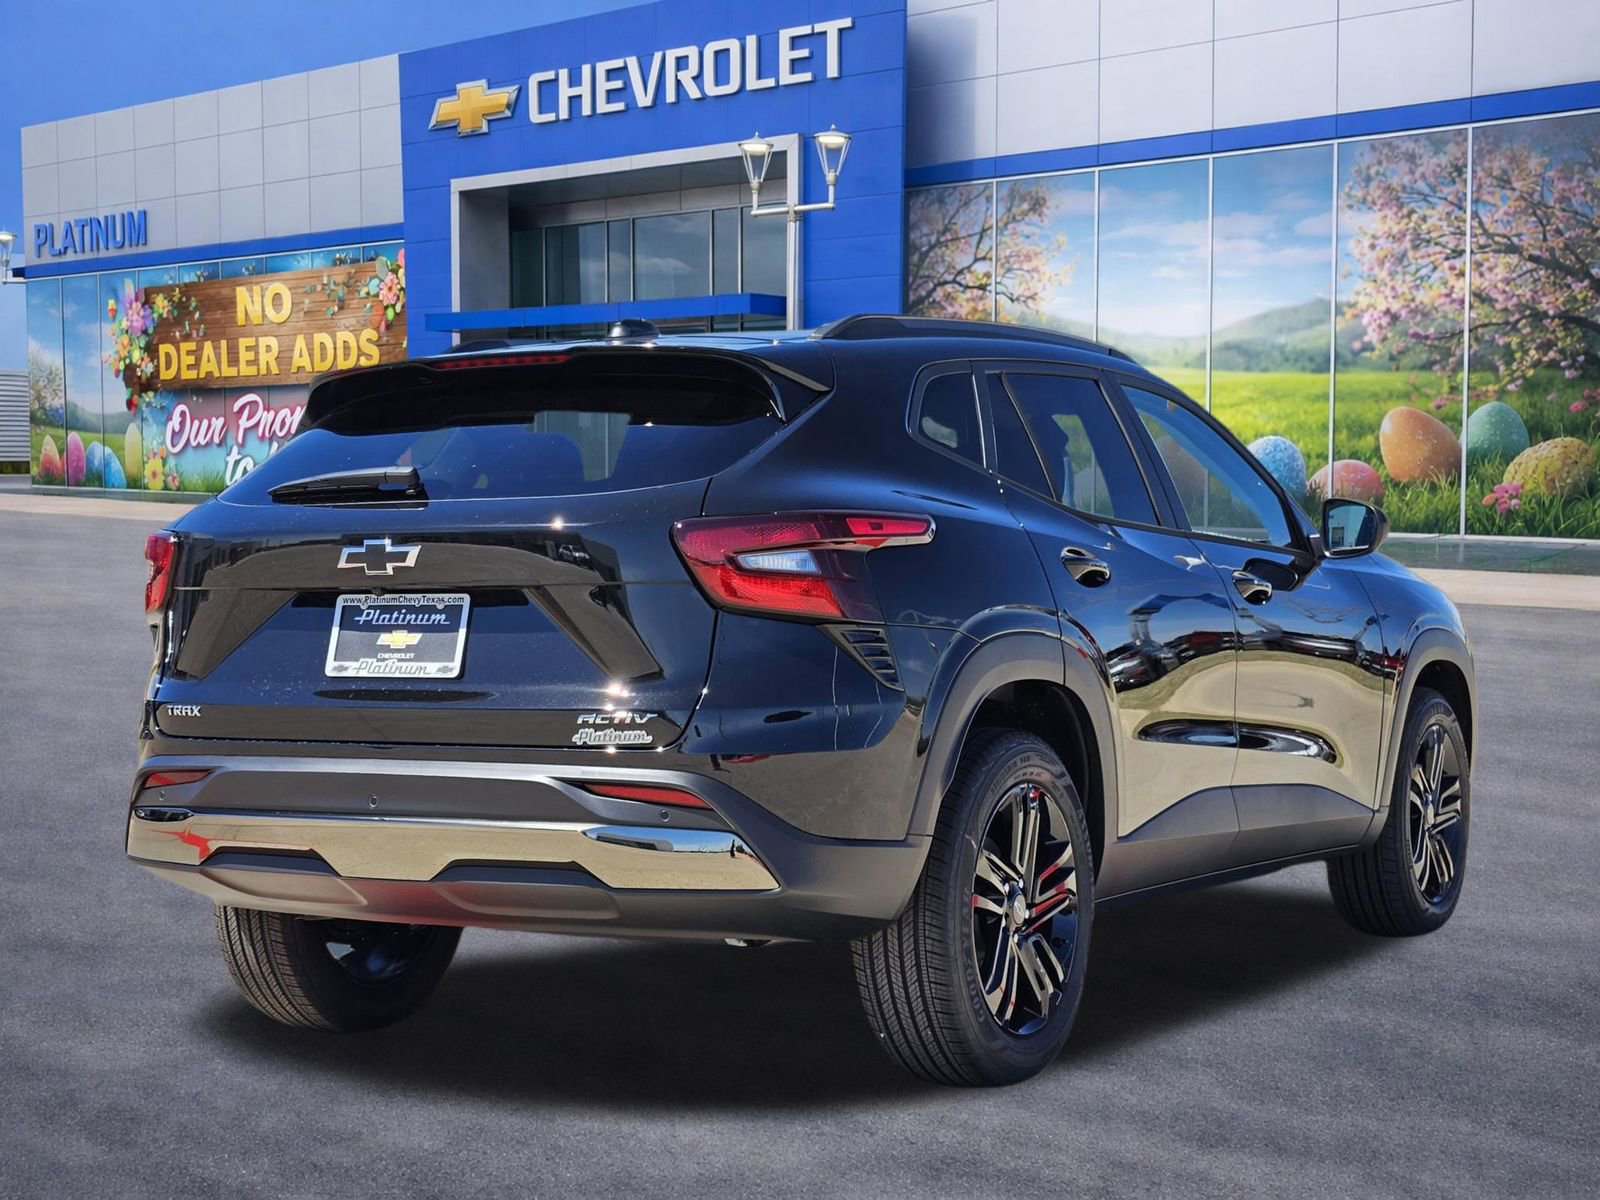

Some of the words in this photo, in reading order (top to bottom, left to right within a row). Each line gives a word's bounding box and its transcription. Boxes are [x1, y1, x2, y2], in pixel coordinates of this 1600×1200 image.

[528, 16, 854, 125] CHEVROLET
[34, 209, 147, 259] PLATINUM
[235, 282, 292, 326] NO
[158, 335, 280, 380] DEALER
[290, 328, 380, 374] ADDS
[165, 403, 228, 454] Our
[342, 595, 465, 605] www.PlatinumChevyTexas.com
[354, 608, 451, 625] Platinum
[352, 659, 431, 675] Platinum
[166, 705, 201, 716] TRAX
[576, 712, 658, 724] ACTIV
[572, 728, 653, 745] Platinum
